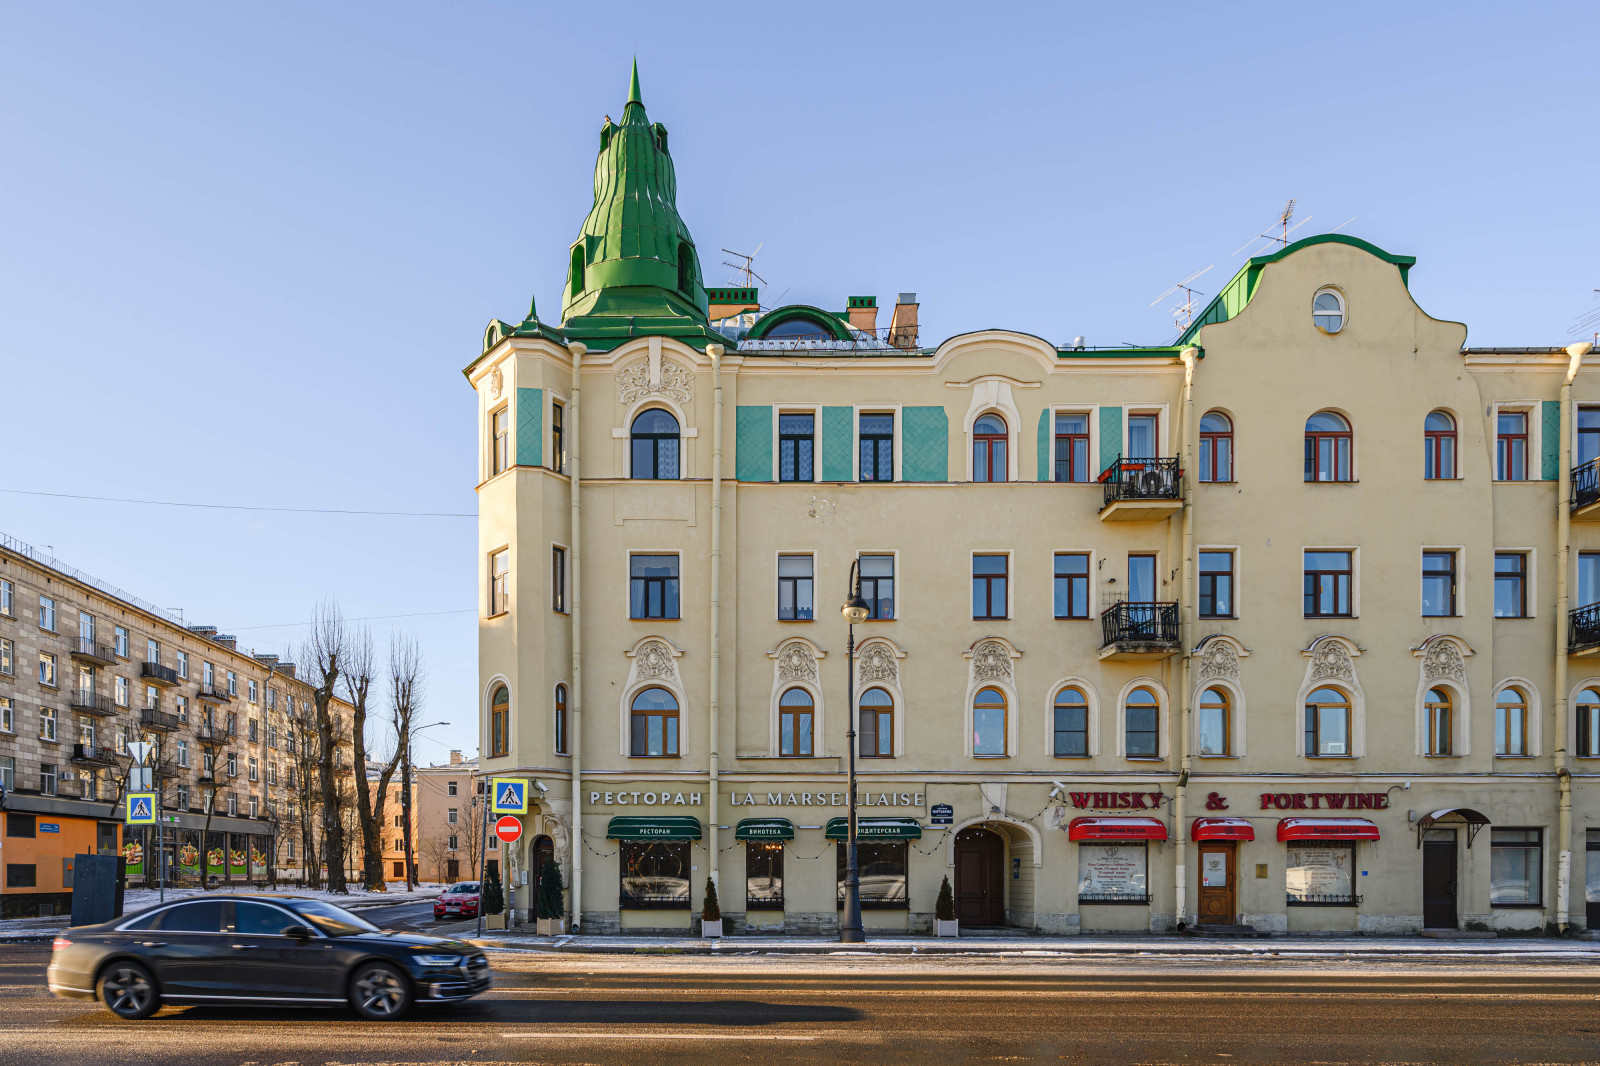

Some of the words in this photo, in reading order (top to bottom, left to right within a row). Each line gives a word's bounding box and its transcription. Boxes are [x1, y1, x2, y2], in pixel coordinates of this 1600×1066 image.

[590, 791, 701, 805] РЕСТОРАН
[731, 792, 756, 806] LA
[767, 792, 924, 806] MARSEILAISE
[1069, 792, 1164, 808] WHISKY
[1206, 792, 1230, 810] &
[1260, 793, 1389, 809] PORTWINE
